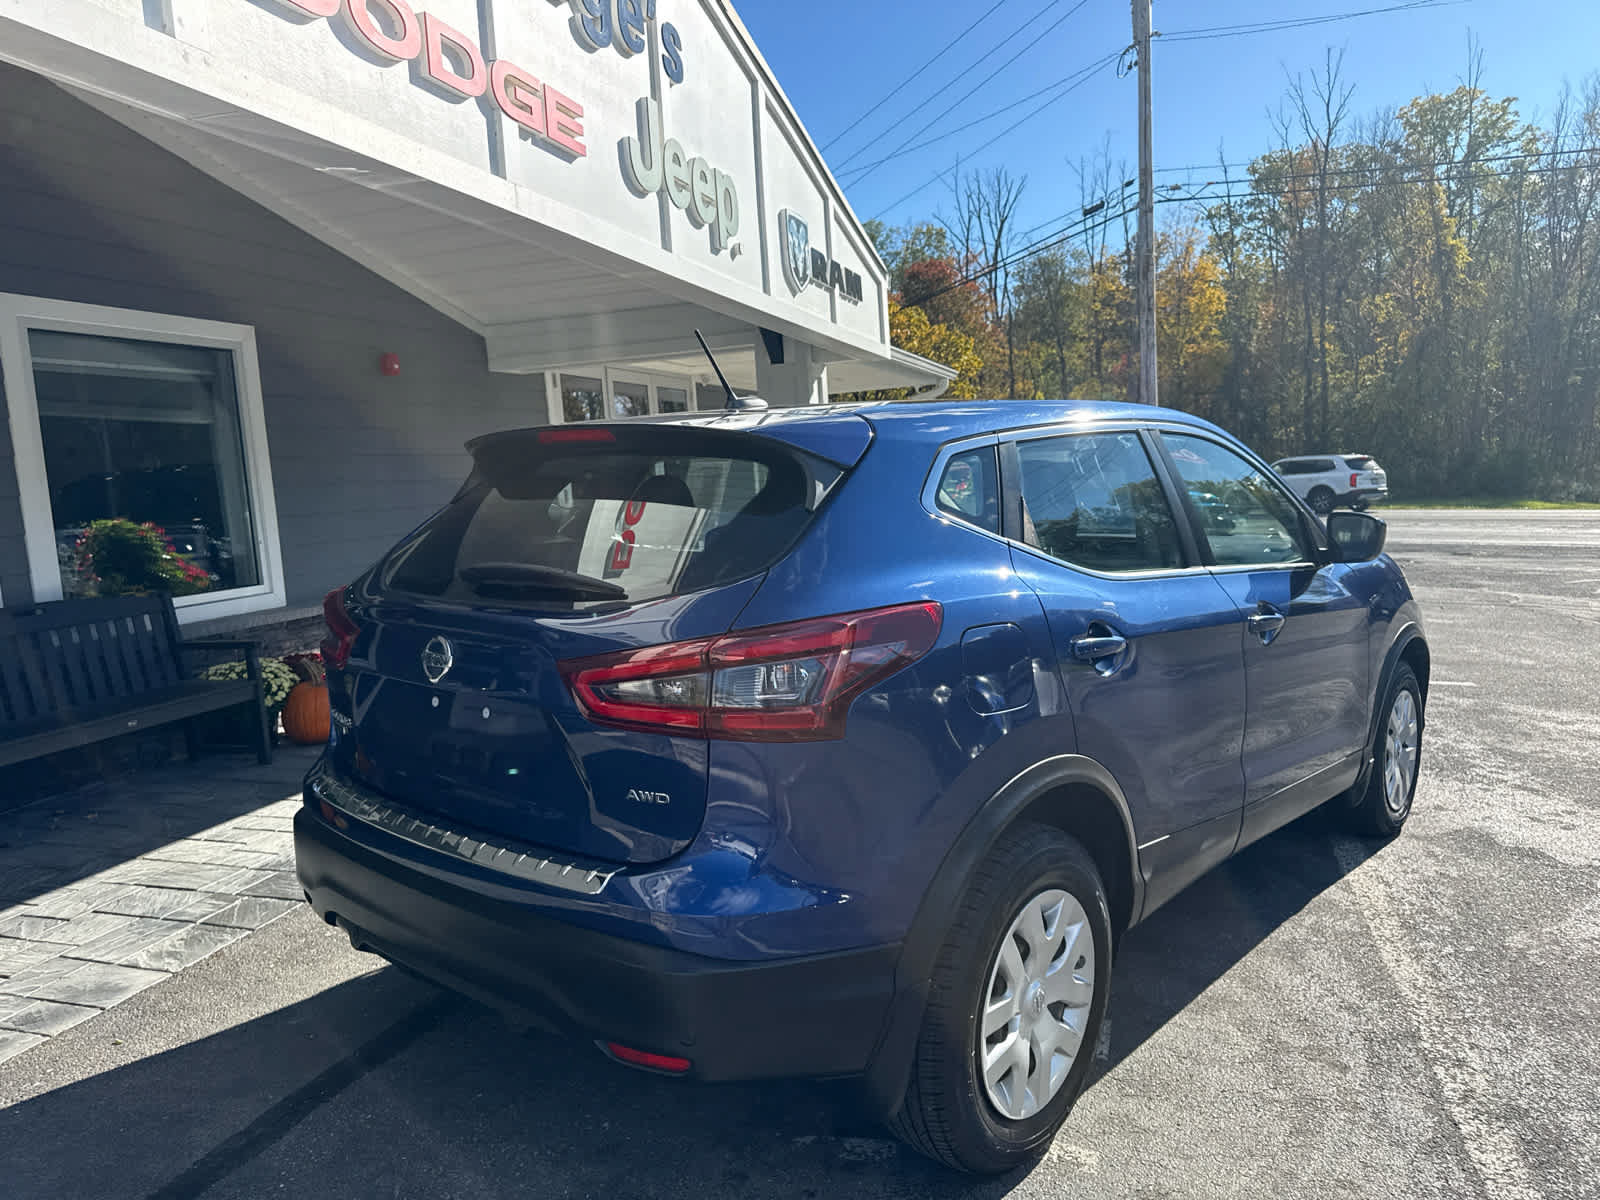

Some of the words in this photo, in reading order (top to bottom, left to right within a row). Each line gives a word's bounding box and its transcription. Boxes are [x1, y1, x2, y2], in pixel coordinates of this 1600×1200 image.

[286, 0, 587, 157] ODGE
[810, 247, 863, 302] RAM
[626, 788, 670, 804] AWD
